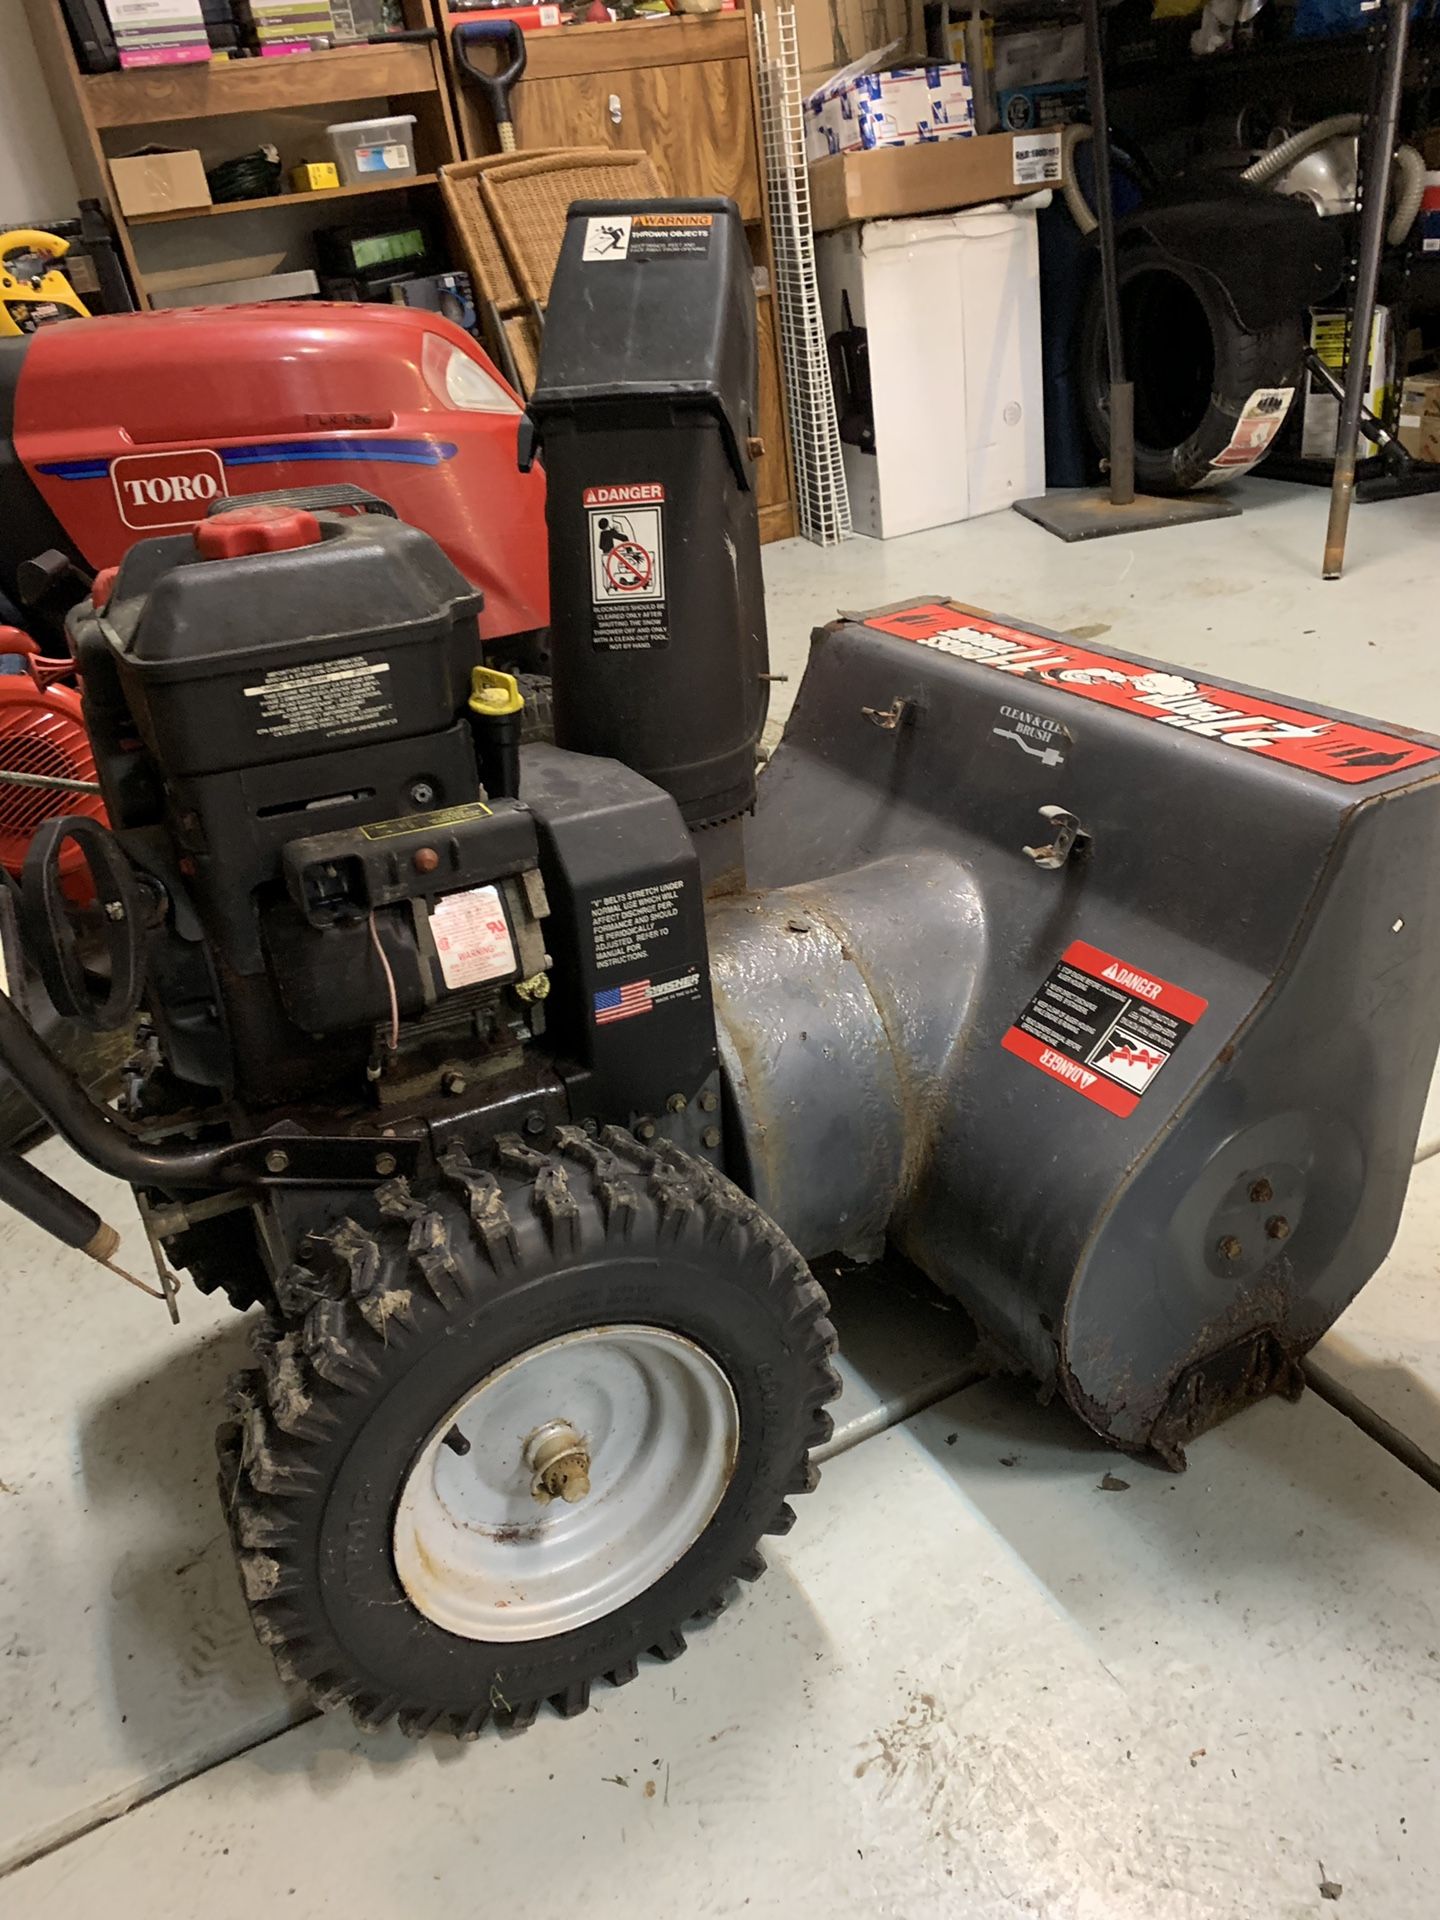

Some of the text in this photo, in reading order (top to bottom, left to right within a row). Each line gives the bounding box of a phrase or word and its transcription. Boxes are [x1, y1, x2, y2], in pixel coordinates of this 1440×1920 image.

[645, 215, 710, 226] WARNING
[632, 230, 709, 239] THROWN OBJECTS
[123, 473, 217, 506] TORO
[597, 485, 662, 502] DANGER
[1000, 705, 1034, 723] CLEAN
[1031, 716, 1041, 727] &
[1015, 722, 1053, 742] BRUSH
[603, 894, 626, 905] BELTS
[626, 886, 659, 900] STRETCH
[660, 880, 684, 892] UNDER
[592, 891, 678, 917] NORMAL USE WHICH WILL
[592, 913, 620, 925] AFFECT
[593, 908, 678, 934] FORMANCE AND SHOULD
[594, 923, 655, 943] BE PERIODICALLY
[636, 930, 659, 941] REFER
[660, 927, 669, 936] TO
[458, 946, 495, 961] WARNING
[596, 943, 641, 960] MANUAL FOR
[644, 973, 700, 998] SWISHER
[1115, 968, 1163, 1001] DANGER
[1039, 1049, 1088, 1084] DANGER
